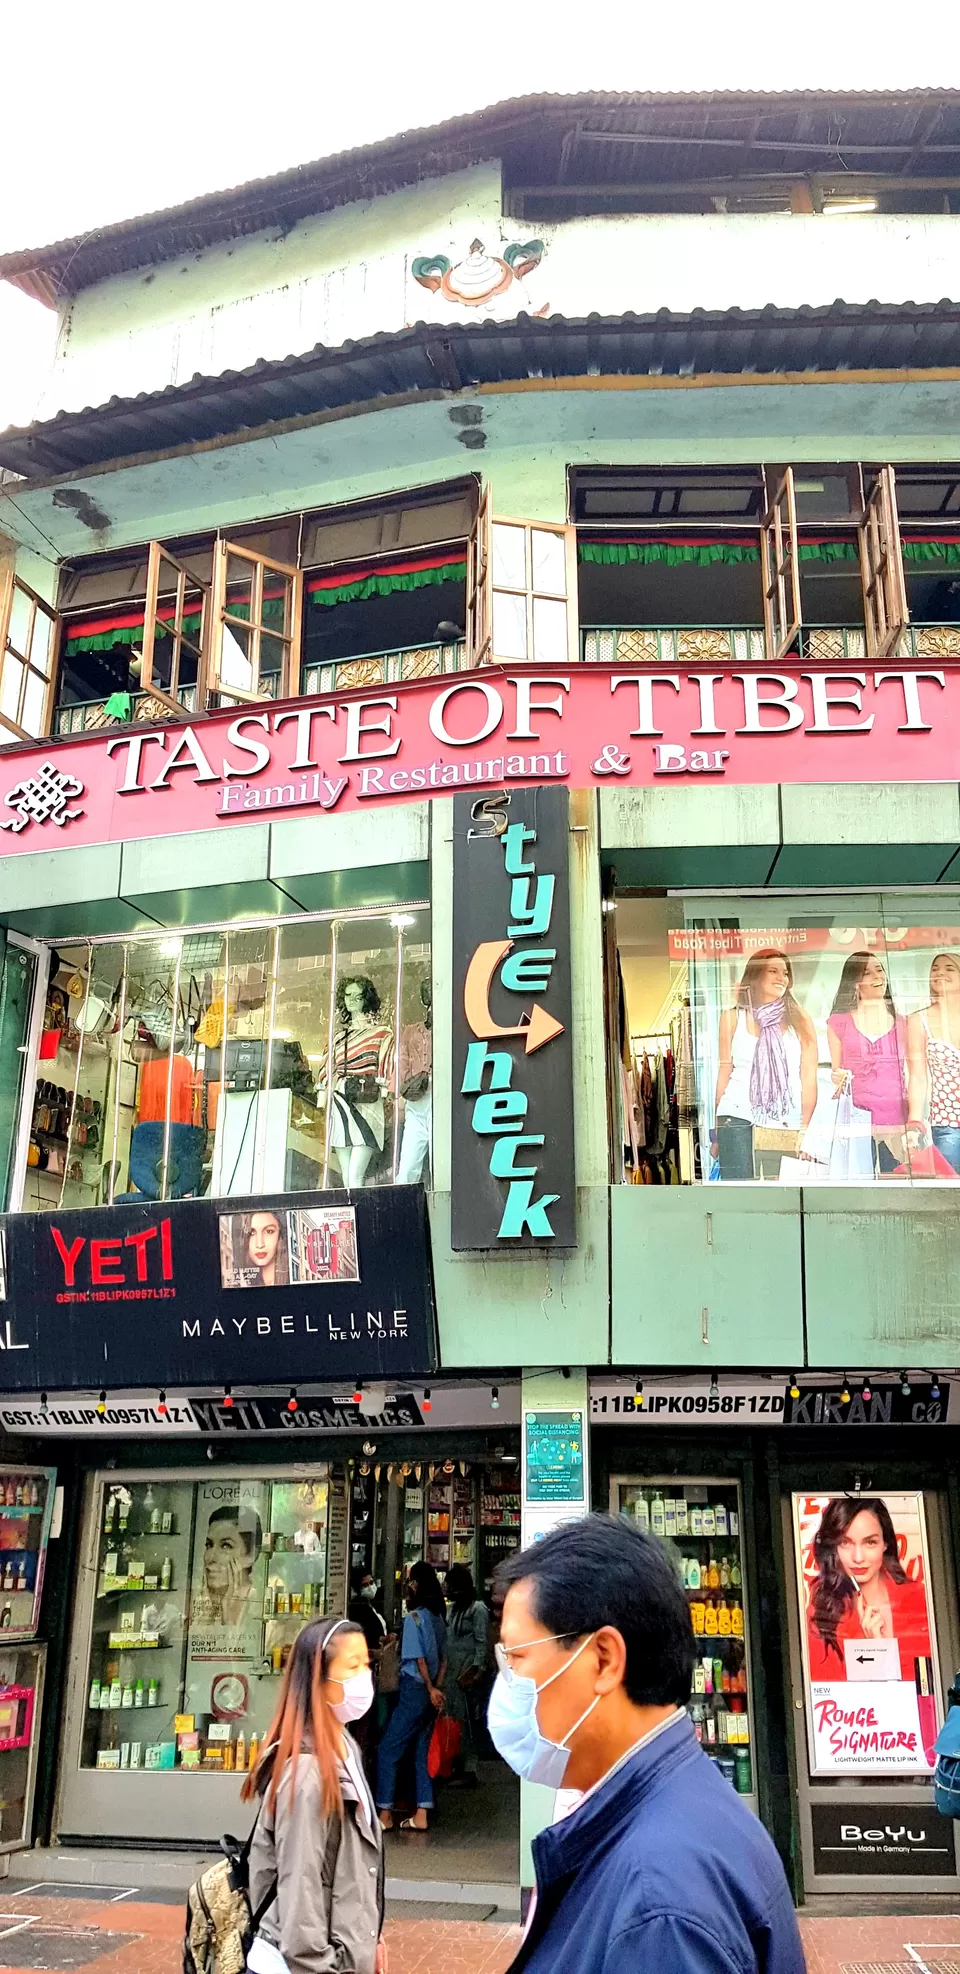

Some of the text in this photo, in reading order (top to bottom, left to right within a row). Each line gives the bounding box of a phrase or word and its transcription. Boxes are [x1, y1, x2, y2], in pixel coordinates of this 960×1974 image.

[107, 670, 946, 795] TASTE OF TIBET
[216, 743, 729, 816] Family Restaurant & Bar
[51, 1217, 173, 1287] YETI
[0, 1320, 29, 1350] L
[182, 1310, 408, 1338] MAYBELLINE
[329, 1329, 409, 1341] NEW YORK
[191, 1401, 266, 1431] YETI
[790, 1391, 893, 1424] KIRAN
[883, 1845, 911, 1854] Germany
